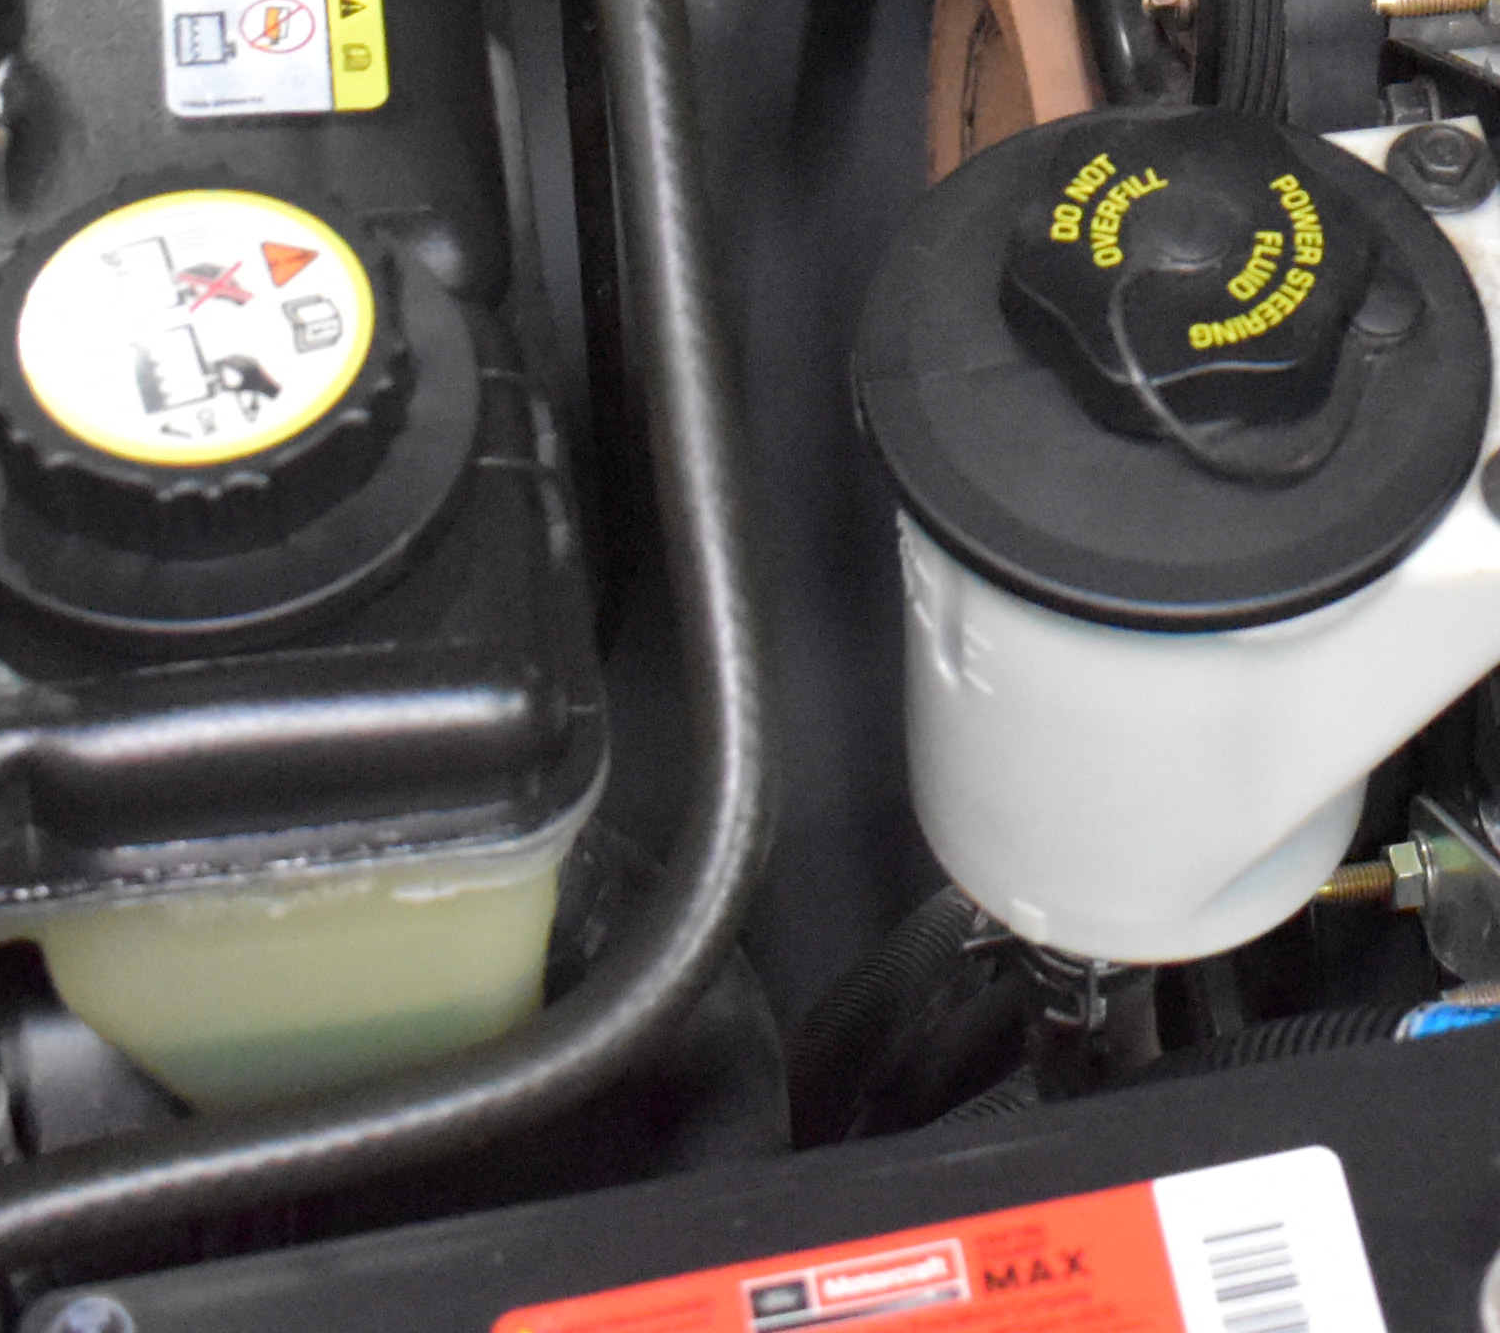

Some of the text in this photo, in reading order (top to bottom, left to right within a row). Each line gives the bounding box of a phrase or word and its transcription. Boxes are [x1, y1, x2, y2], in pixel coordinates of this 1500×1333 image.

[1051, 153, 1117, 242] DO NOT
[1090, 167, 1169, 268] OVERFILL
[1188, 173, 1323, 349] POWER STEERING
[1227, 230, 1283, 301] FLUID
[983, 1250, 1091, 1294] MAX
